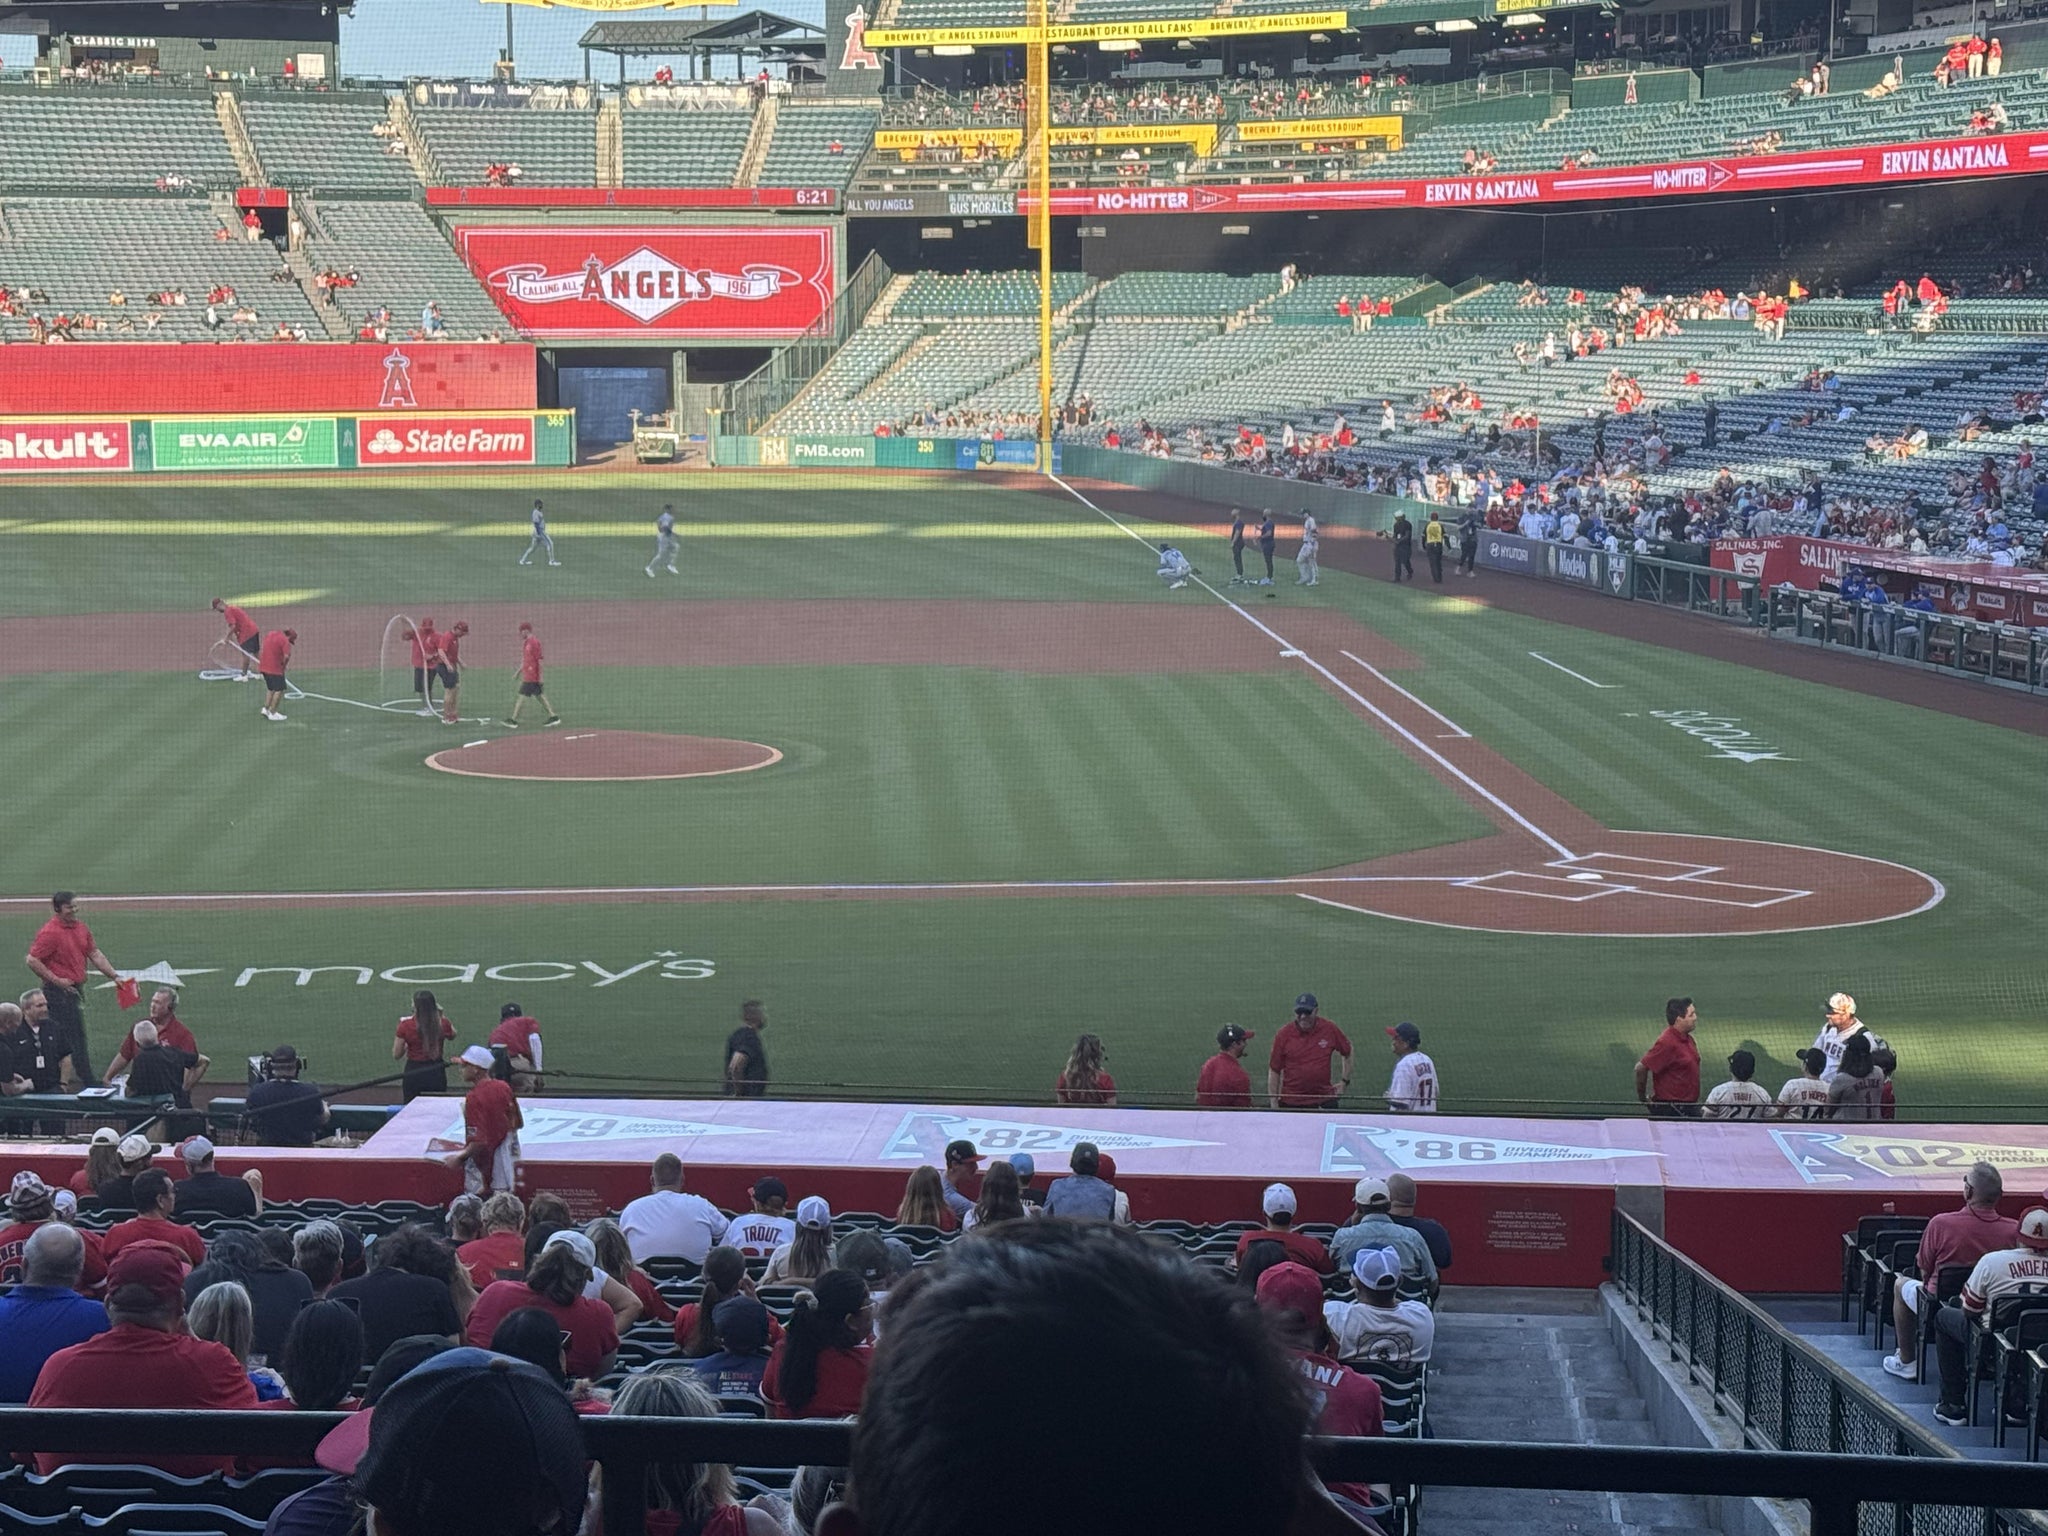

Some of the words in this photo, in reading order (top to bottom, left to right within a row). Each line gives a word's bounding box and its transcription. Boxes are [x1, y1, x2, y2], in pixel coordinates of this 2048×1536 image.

[884, 33, 927, 42] BREWERY
[948, 31, 976, 40] ANGEL
[978, 30, 1018, 39] STADIUM
[1104, 26, 1130, 36] OPEN
[1132, 25, 1145, 35] TO
[1147, 24, 1165, 34] ALL
[1167, 23, 1193, 33] FANS
[1210, 20, 1249, 31] BREWERY
[1267, 18, 1294, 27] ANGEL
[1296, 16, 1333, 26] STADIUM
[73, 36, 124, 46] CLASSIC
[1882, 149, 1931, 175] ERVIN
[1932, 143, 2010, 172] SANTANA
[1653, 167, 1707, 189] NO-HITTER
[796, 190, 828, 205] 6:21
[1425, 181, 1472, 203] ERVIN
[1474, 179, 1540, 200] SANTANA
[847, 199, 863, 211] ALL
[864, 199, 881, 211] YOU
[882, 198, 914, 211] ANGELS
[950, 201, 970, 215] GUS
[971, 201, 1014, 214] MORALES
[1097, 192, 1189, 209] NO-HITTER
[522, 282, 560, 296] CALLING
[561, 281, 578, 293] ALL
[581, 260, 712, 300] ANGELS
[727, 281, 752, 295] 1961
[547, 414, 565, 428] 365
[178, 433, 231, 448] EVA
[232, 432, 277, 447] AIR
[917, 440, 934, 453] 350
[795, 444, 865, 458] FMB.com
[1500, 545, 1529, 562] HYUNDAI
[1715, 541, 1761, 551] SALINAS,
[1763, 540, 1784, 550] INC.
[1558, 549, 1587, 579] Modelo
[1418, 1078, 1433, 1107] 17
[530, 1117, 618, 1138] '79
[967, 1127, 1063, 1149] '82
[1064, 1139, 1153, 1147] CMPIONS
[1068, 1133, 1133, 1142] DIVISION
[1396, 1139, 1497, 1161] '86
[1502, 1151, 1593, 1159] CHAMPIONS
[1504, 1145, 1570, 1154] DIVISION
[1853, 1145, 1973, 1168] '02
[1970, 1149, 2035, 1157] WORLD
[742, 1225, 783, 1244] TROUT
